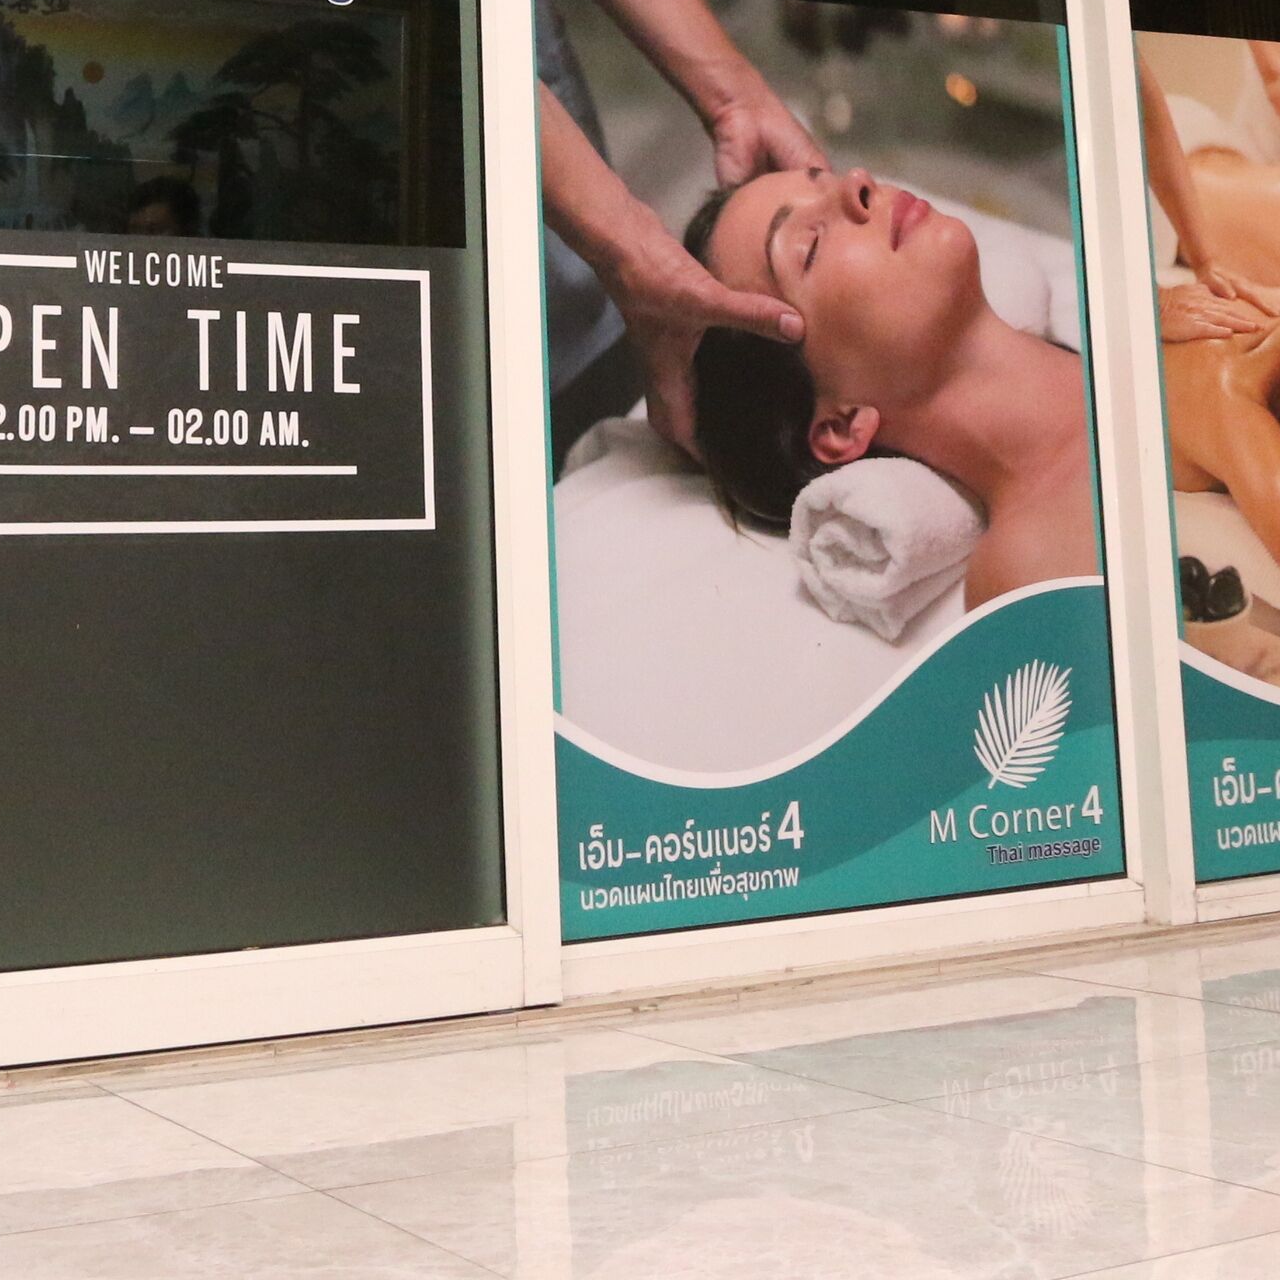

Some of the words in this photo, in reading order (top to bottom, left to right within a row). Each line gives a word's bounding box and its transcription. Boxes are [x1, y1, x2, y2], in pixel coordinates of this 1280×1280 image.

[84, 249, 224, 289] WELCOME
[187, 309, 361, 394] TIME
[66, 406, 120, 443] PM.
[167, 408, 248, 445] 02.00
[260, 411, 310, 447] AM.
[777, 801, 805, 856] 4
[930, 809, 957, 844] M
[969, 801, 1075, 839] Corner
[1081, 785, 1104, 825] 4
[986, 842, 1023, 867] Thai
[1027, 836, 1102, 862] massage
[580, 862, 799, 911] นวดแผนไทยเพื่อสุขภาพ
